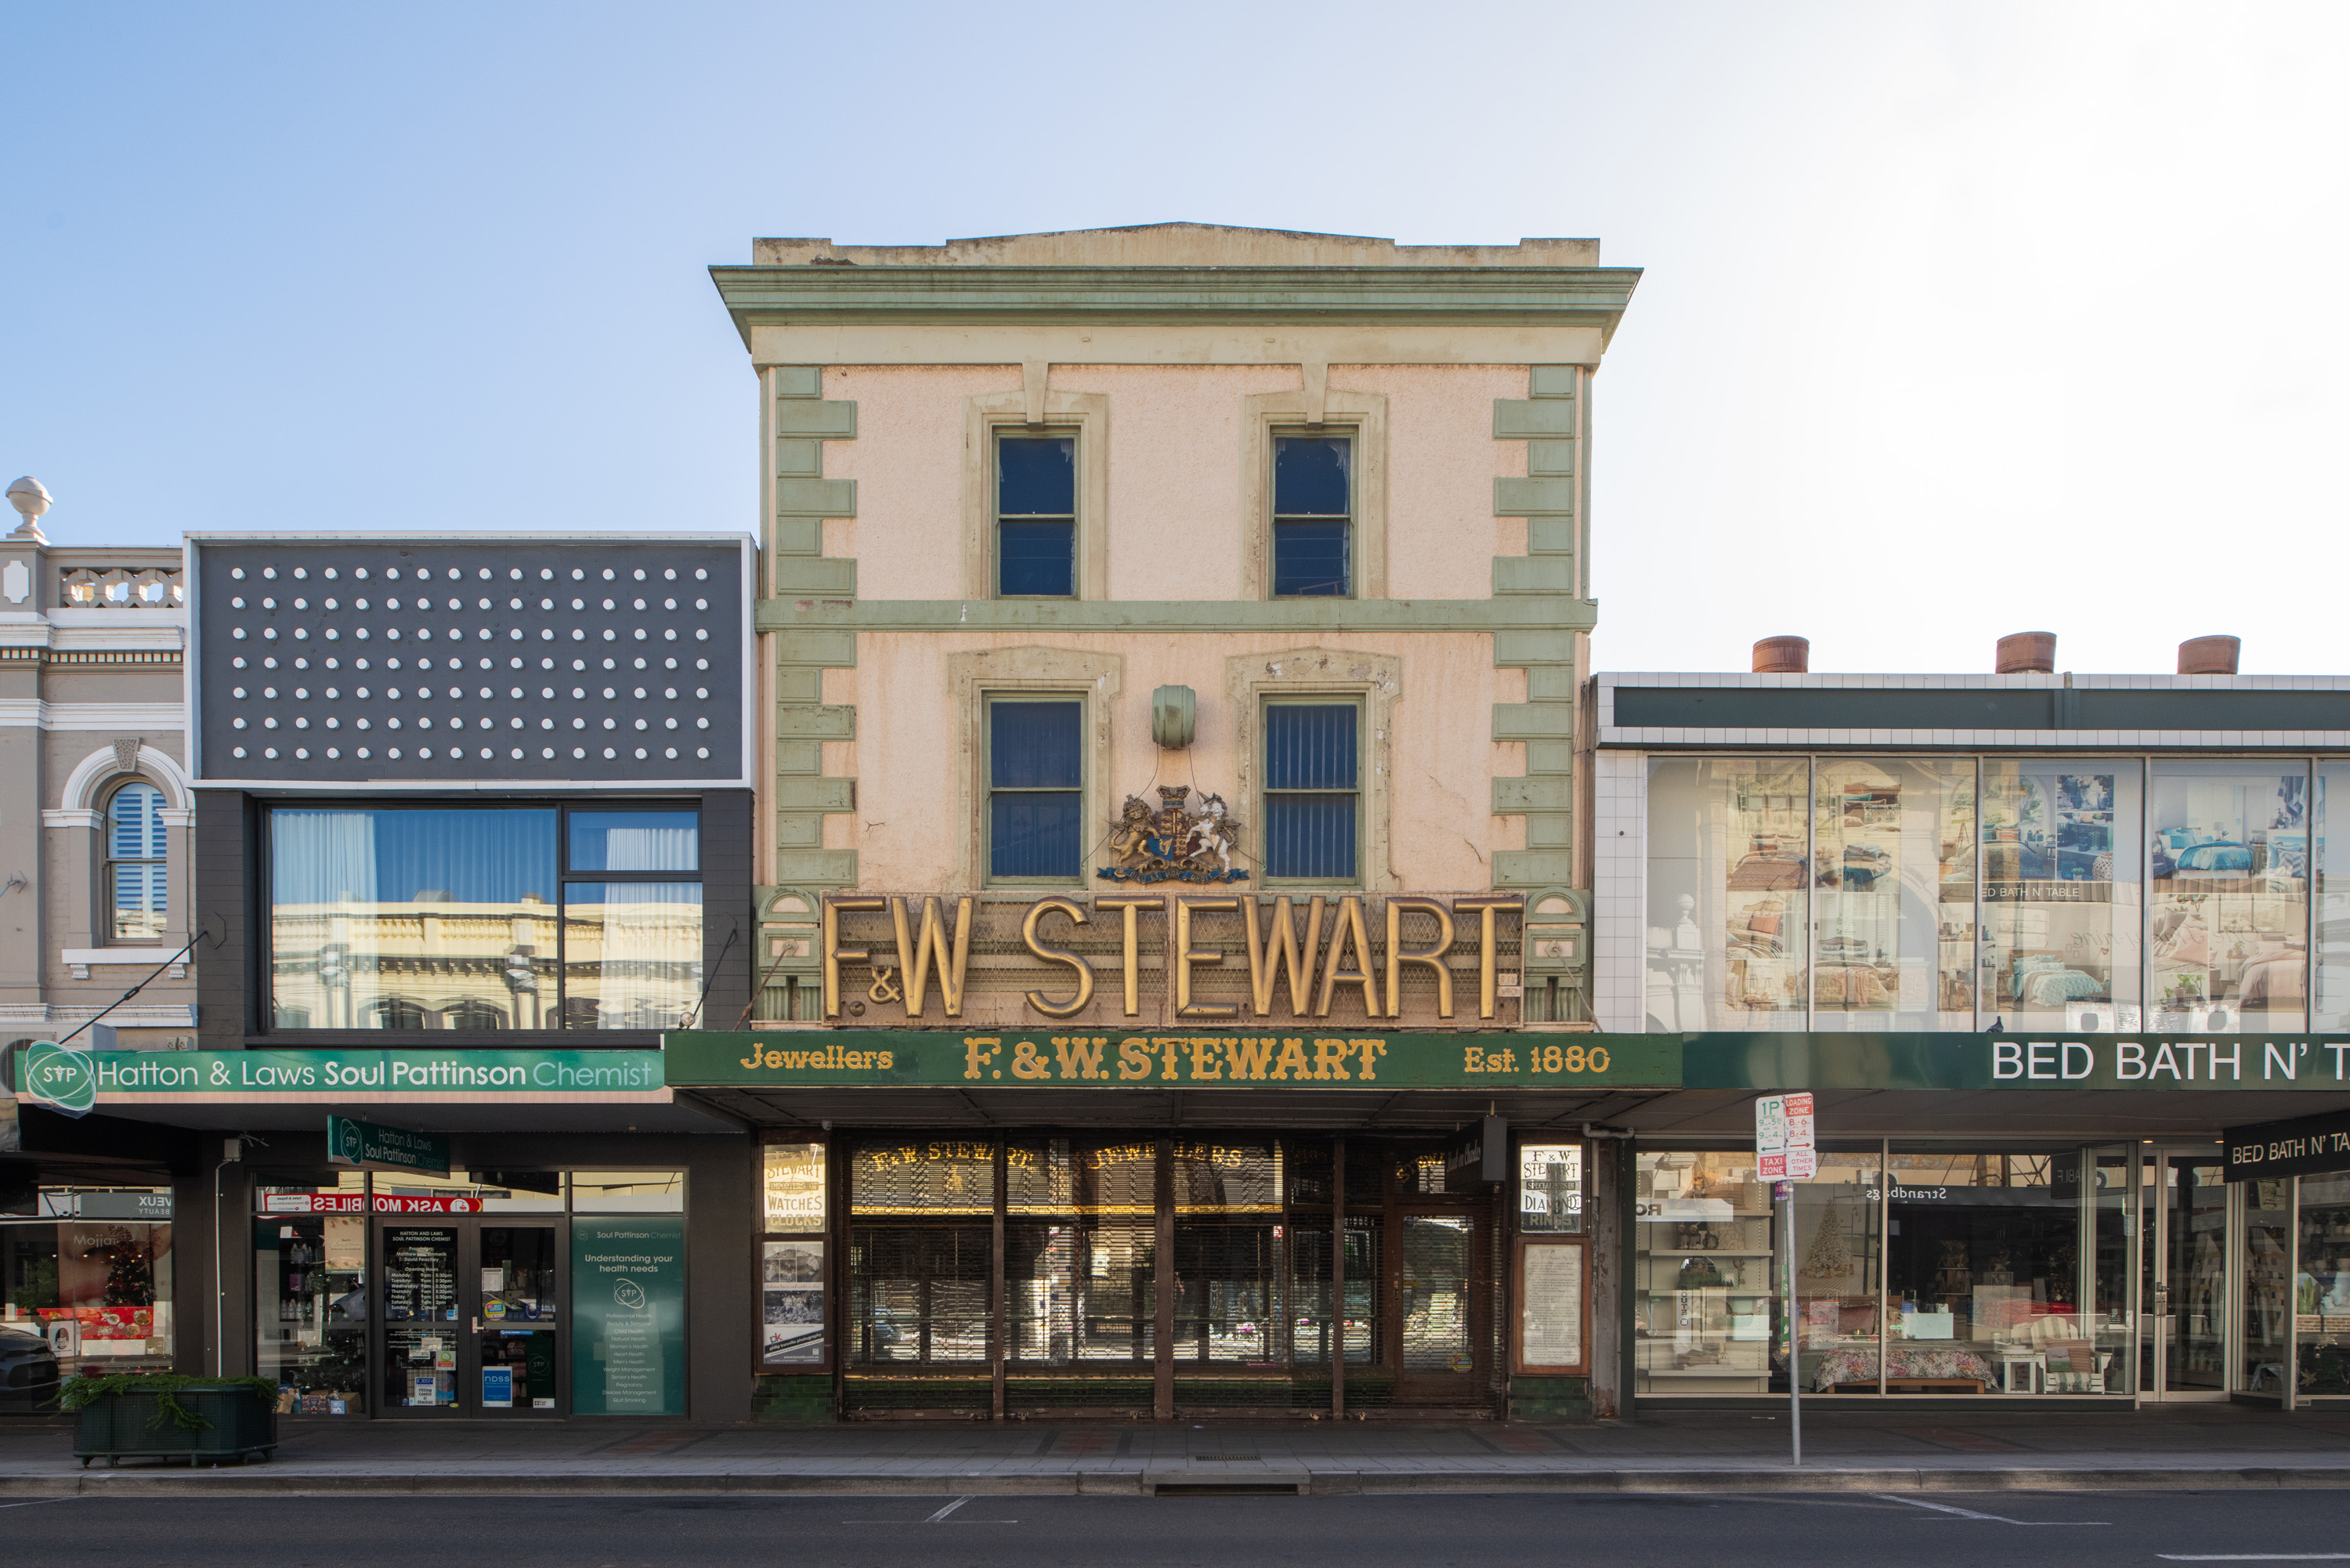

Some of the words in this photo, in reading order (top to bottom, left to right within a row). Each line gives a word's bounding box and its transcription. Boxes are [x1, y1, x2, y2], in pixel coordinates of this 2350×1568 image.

[1130, 872, 1147, 882] DIEU
[1150, 872, 1160, 880] ET
[1165, 869, 1180, 878] MON
[1190, 873, 1213, 883] DROIT
[1999, 887, 2028, 898] BATH
[2045, 887, 2080, 898] TABLE
[1021, 894, 1524, 1020] STEWART
[740, 1042, 894, 1070] Jewellers
[1119, 1036, 1387, 1081] STEWART
[1464, 1046, 1520, 1074] Est.
[1531, 1046, 1611, 1074] 1880
[1992, 1042, 2095, 1080] BED
[2116, 1042, 2240, 1081] BATH
[2264, 1042, 2308, 1081] N'
[98, 1060, 199, 1086] Hatton
[209, 1060, 232, 1086] &
[242, 1061, 315, 1086] Laws
[324, 1060, 386, 1086] Soul
[392, 1060, 526, 1086] Pattinson
[533, 1060, 652, 1087] Chemist
[1762, 1101, 1780, 1115] 1P
[1786, 1098, 1811, 1107] LOADING
[378, 1129, 404, 1146] Hatton
[407, 1137, 412, 1147] &
[414, 1139, 431, 1151] Laws
[365, 1143, 382, 1159] Soul
[383, 1147, 416, 1165] Pattinson
[417, 1153, 444, 1170] Chemist
[775, 1151, 786, 1162] F
[800, 1151, 811, 1162] W
[1087, 1141, 1242, 1169] JEWELERS
[1533, 1151, 1546, 1162] F
[1558, 1151, 1571, 1161] W
[2232, 1143, 2264, 1165] BED
[2269, 1139, 2305, 1161] BATH
[2311, 1135, 2326, 1154] N'
[768, 1165, 819, 1179] STEWART
[1524, 1163, 1578, 1178] STEWART
[768, 1196, 822, 1210] WATCHES
[769, 1214, 821, 1226] CLOCKS
[1530, 1214, 1572, 1226] RINGS
[585, 1255, 650, 1263] Understanding
[796, 1333, 822, 1343] photography
